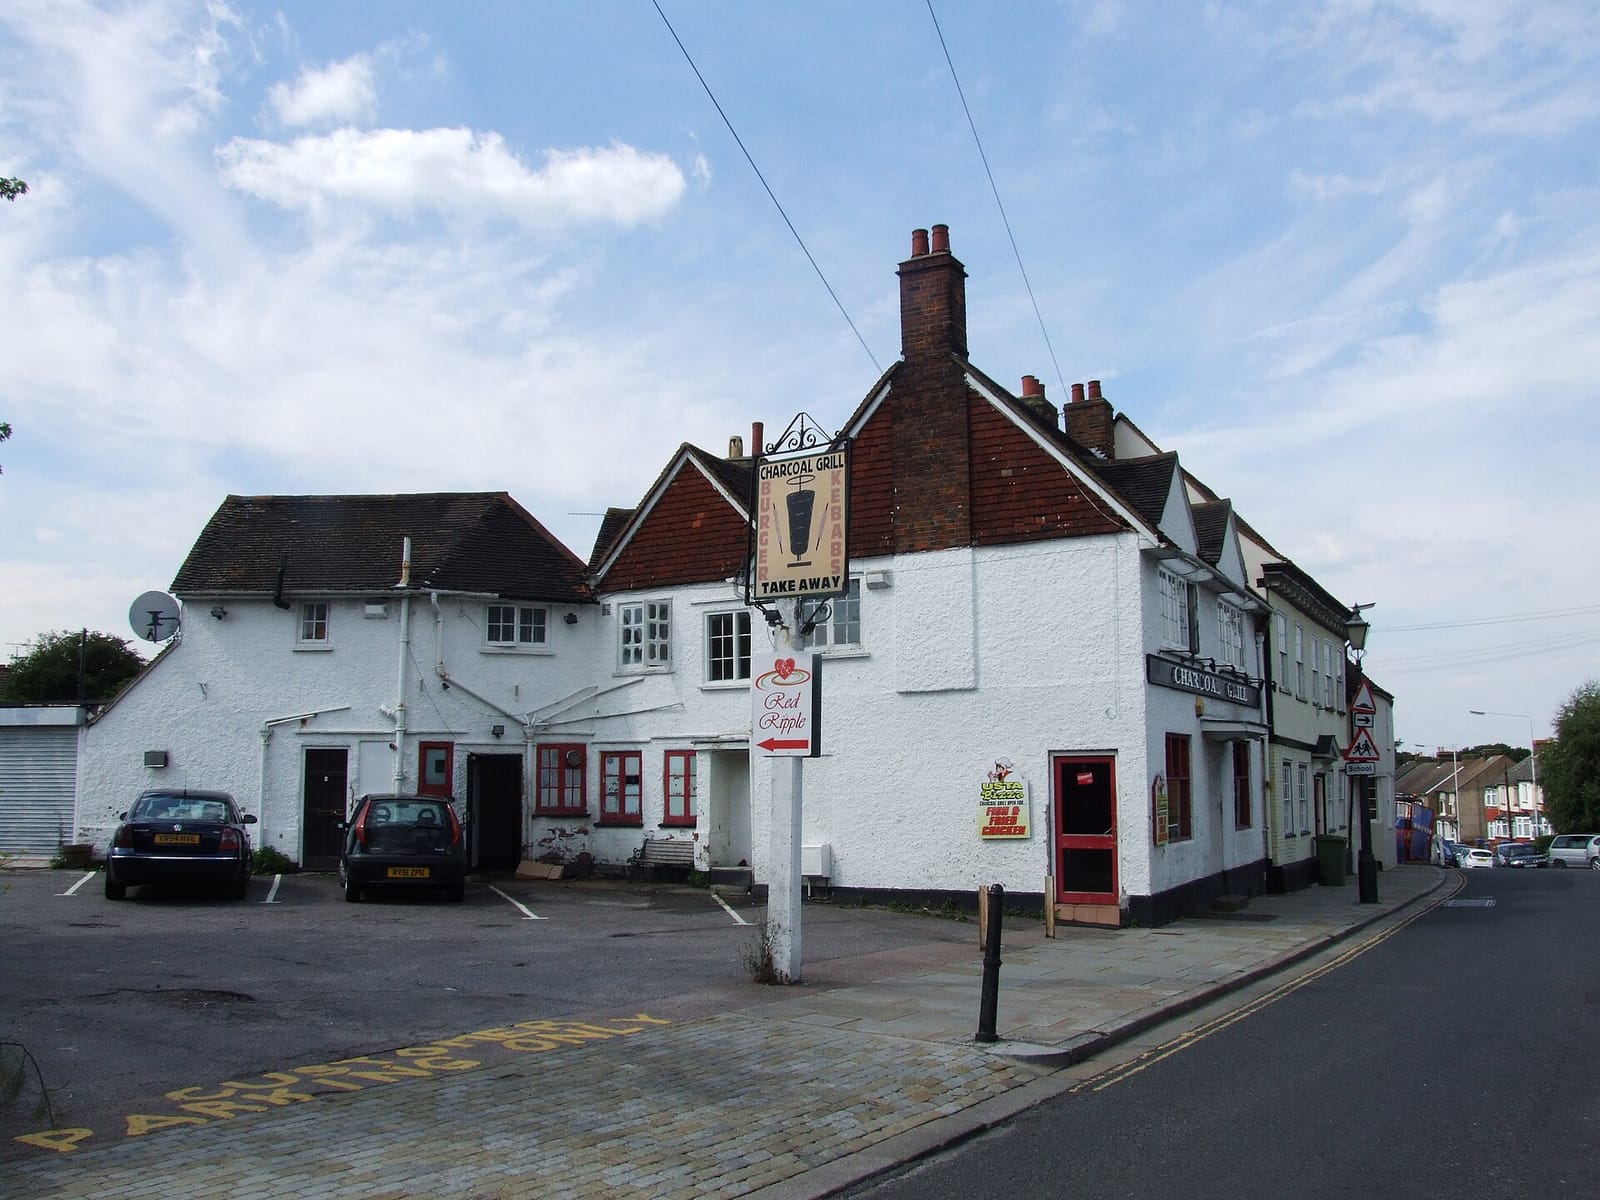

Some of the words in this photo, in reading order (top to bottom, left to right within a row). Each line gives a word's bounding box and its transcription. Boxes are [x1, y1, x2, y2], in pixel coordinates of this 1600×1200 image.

[760, 460, 813, 480] CHARCOAL
[816, 454, 844, 471] GRILL
[758, 480, 771, 581] BURGER
[830, 470, 843, 576] KEBABS
[761, 579, 796, 594] TAKE
[798, 575, 840, 591] AWAY
[764, 691, 801, 710] Red
[759, 711, 807, 735] Ripple
[1348, 765, 1373, 773] School
[980, 790, 1024, 800] Pizza
[981, 782, 1023, 790] USTA
[164, 1019, 586, 1102] CUSTOMER
[13, 1056, 481, 1152] PARKING
[502, 1013, 673, 1051] ONLY
